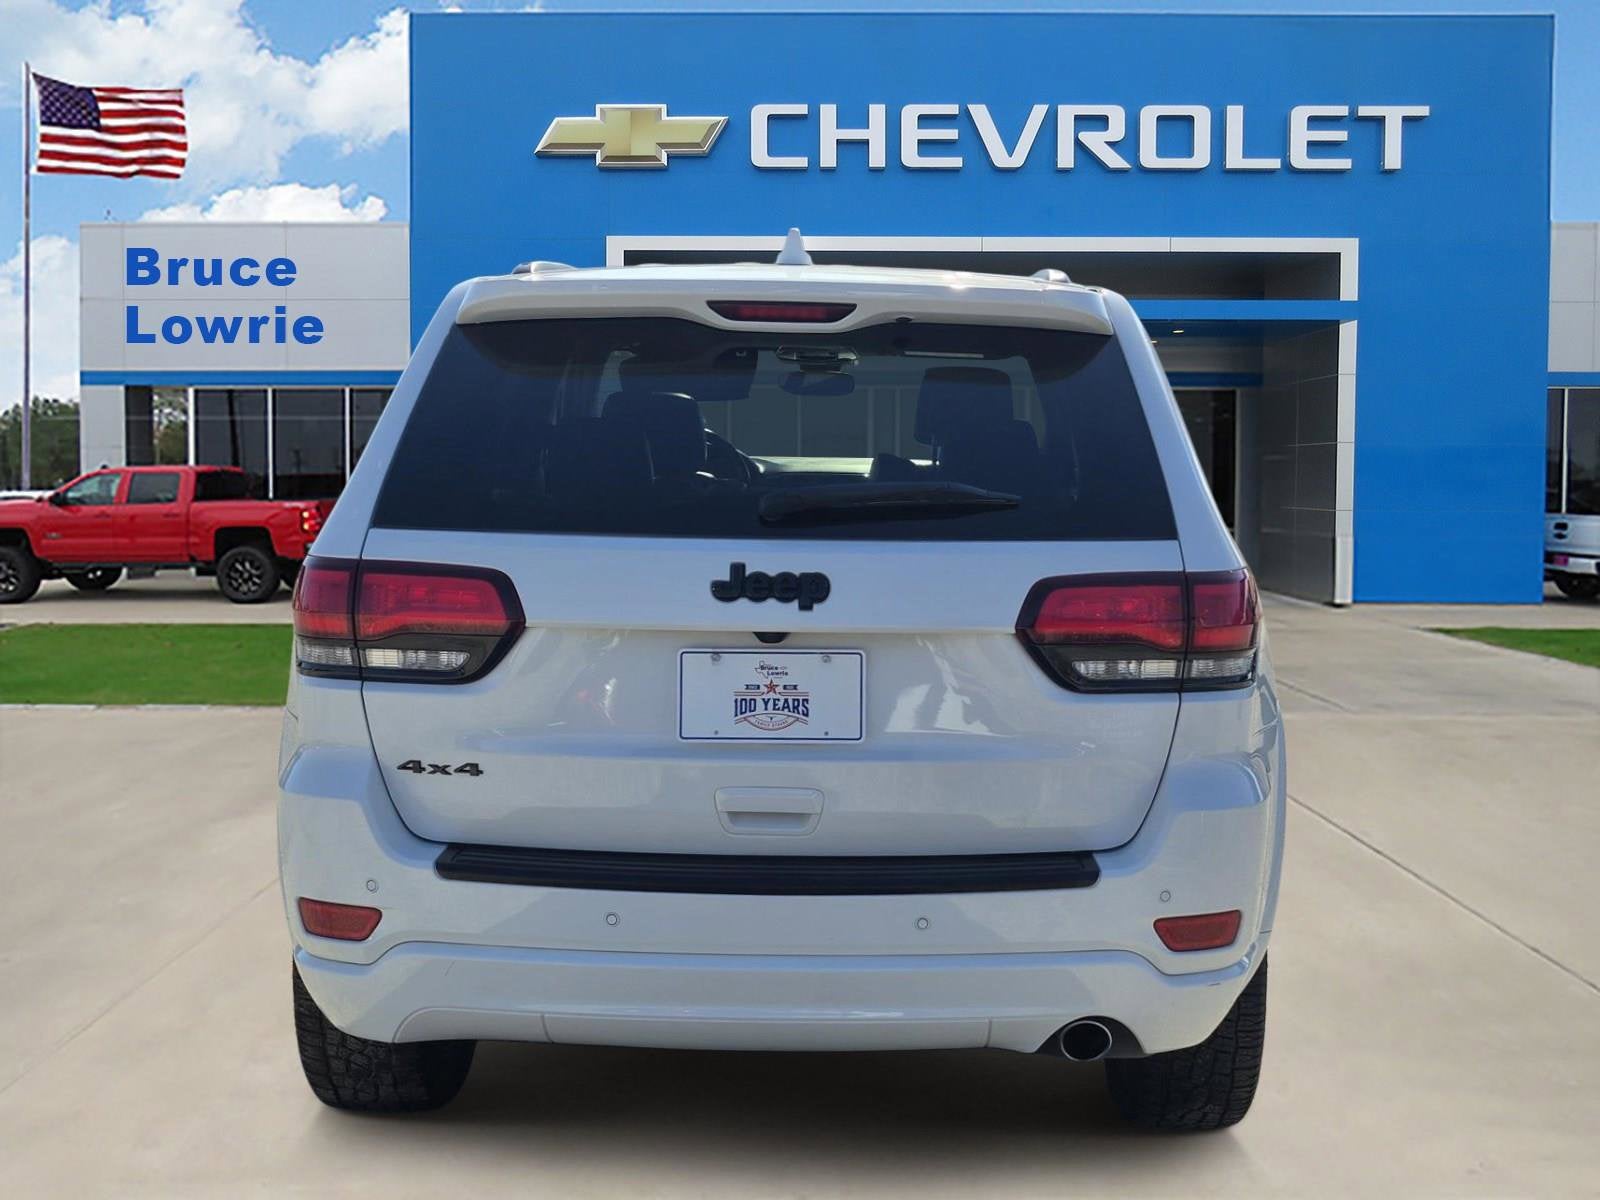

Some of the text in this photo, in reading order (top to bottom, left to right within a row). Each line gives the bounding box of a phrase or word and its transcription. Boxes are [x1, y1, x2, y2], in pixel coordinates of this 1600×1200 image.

[750, 103, 1430, 172] CHEVROLET
[125, 247, 297, 287] Bruce
[125, 305, 325, 345] Lowrie
[710, 562, 831, 611] Jeep
[734, 698, 809, 718] 100 YEARS
[397, 758, 484, 777] 4x4
